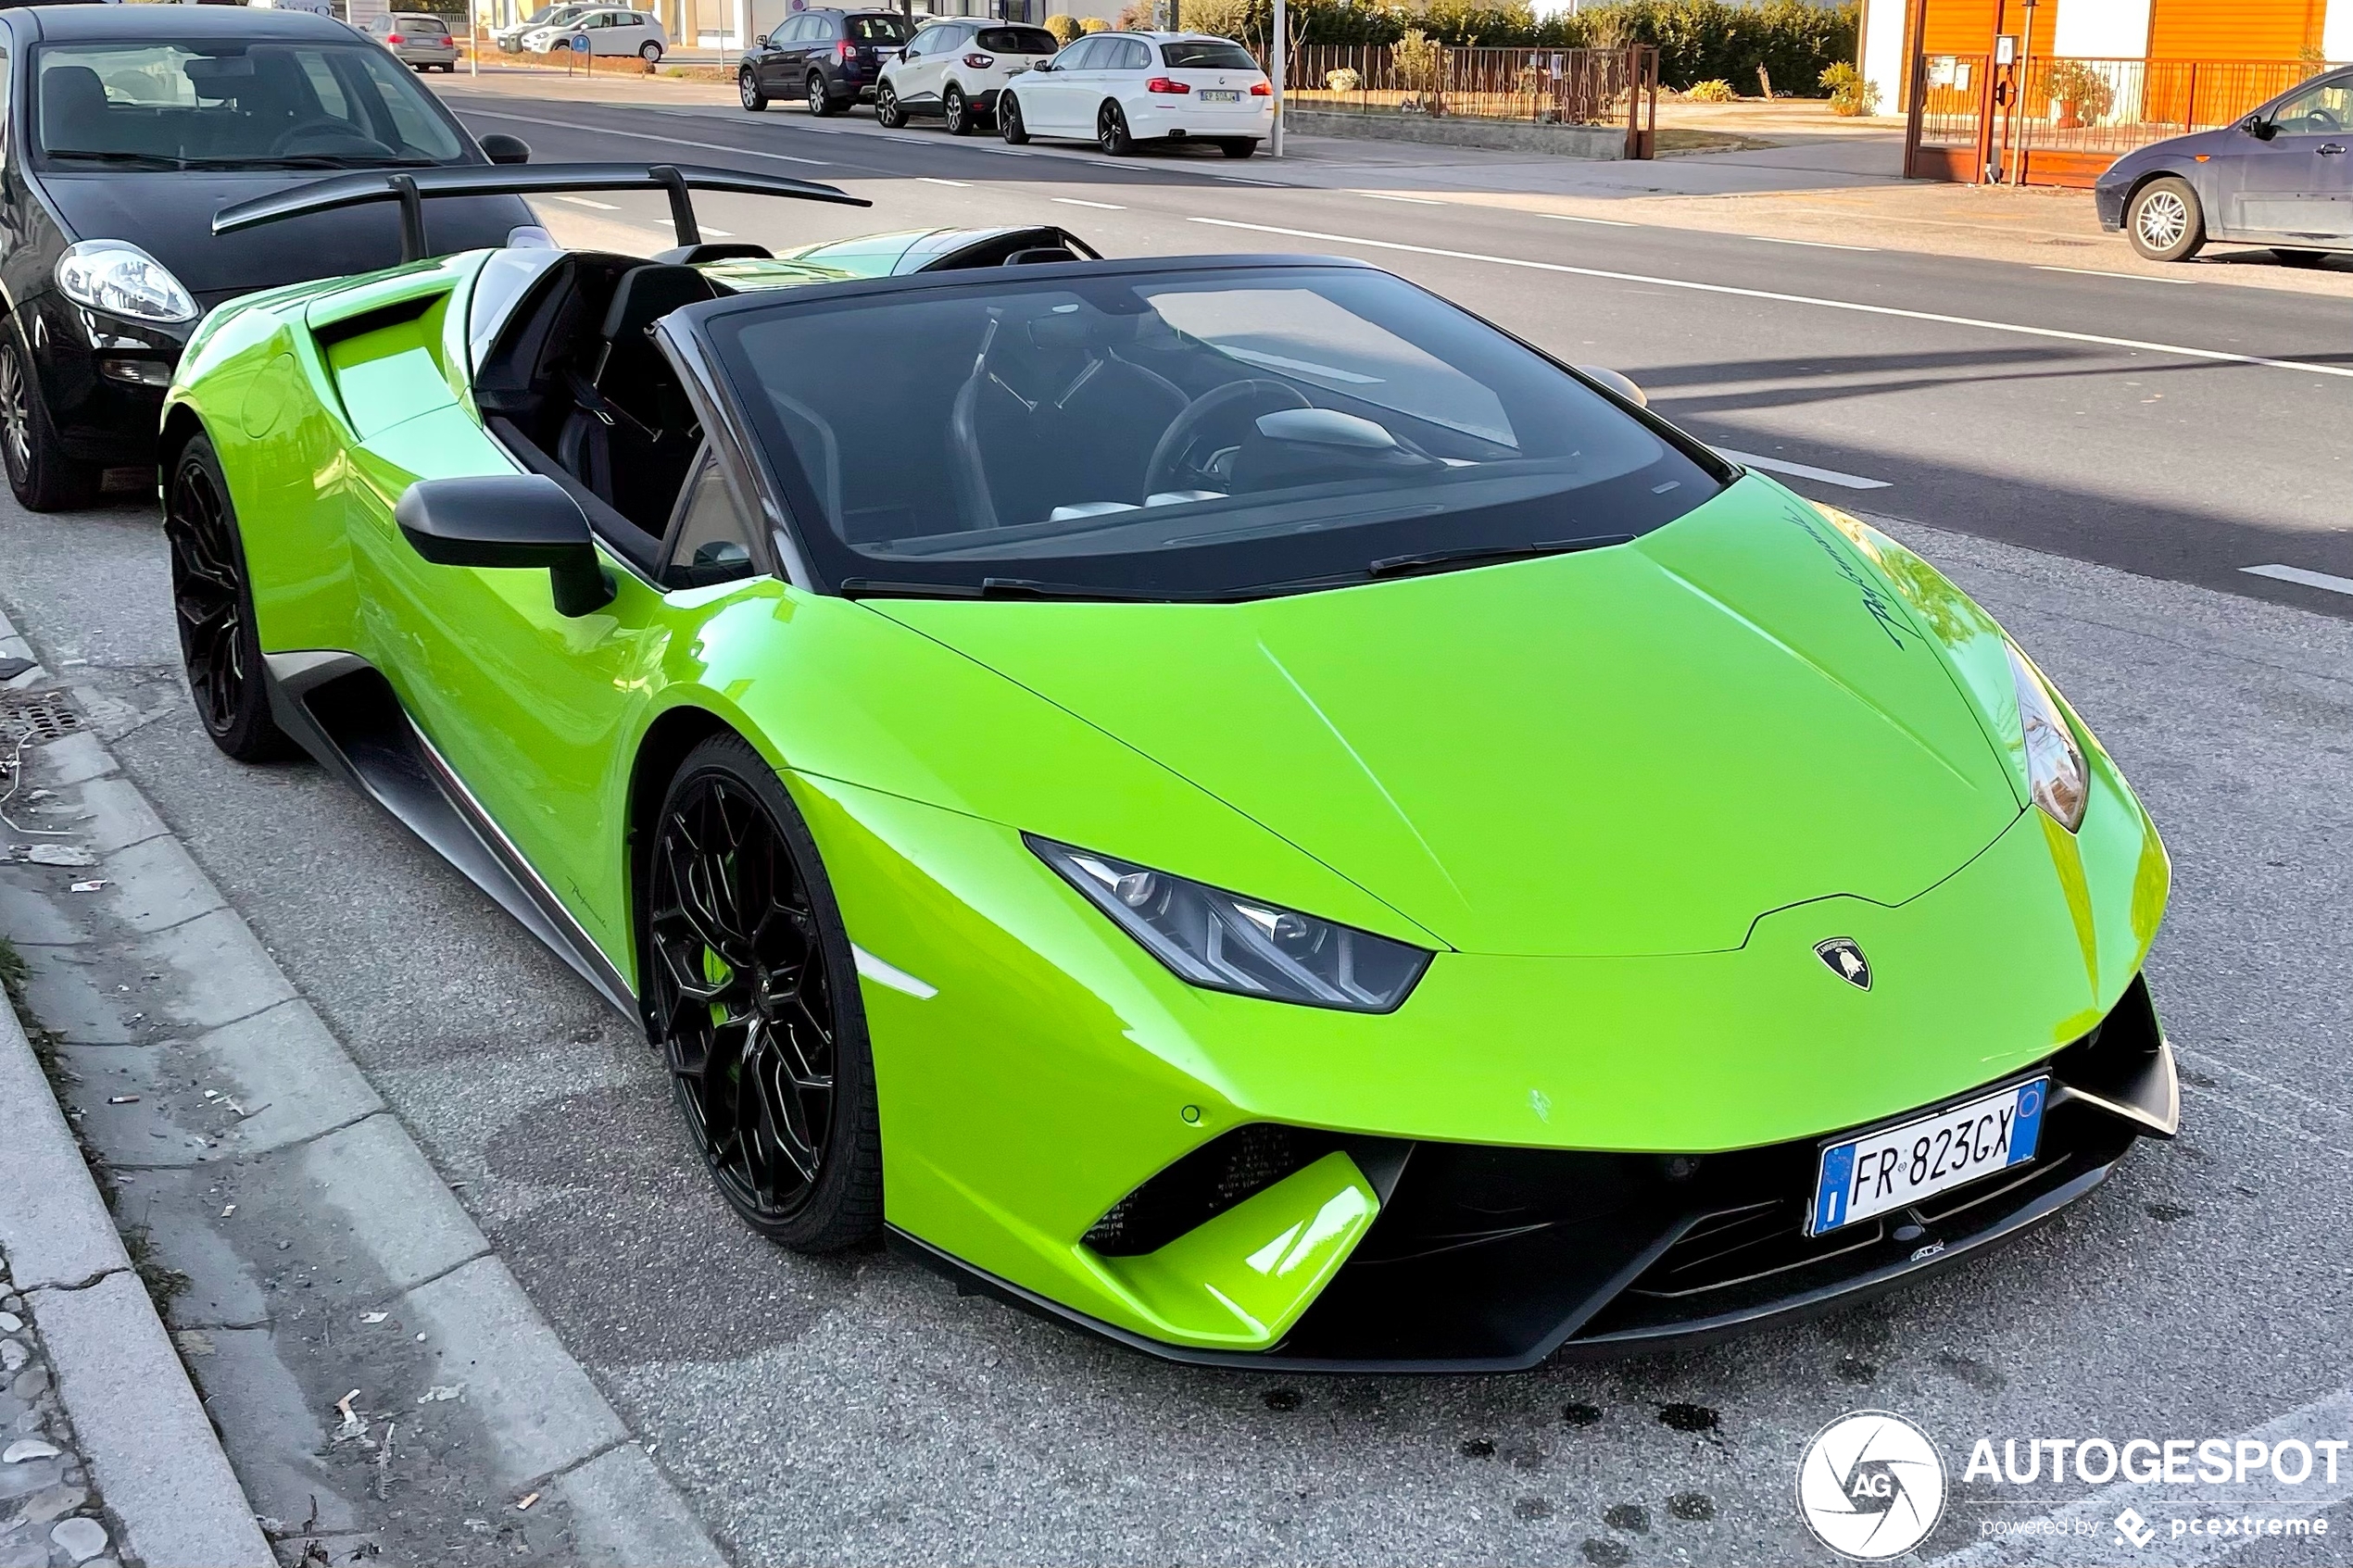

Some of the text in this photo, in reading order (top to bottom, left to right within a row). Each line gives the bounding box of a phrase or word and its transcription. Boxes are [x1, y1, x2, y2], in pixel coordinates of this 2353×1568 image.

[1782, 506, 1922, 652] Performante
[1852, 1105, 2015, 1206] FR 823GX
